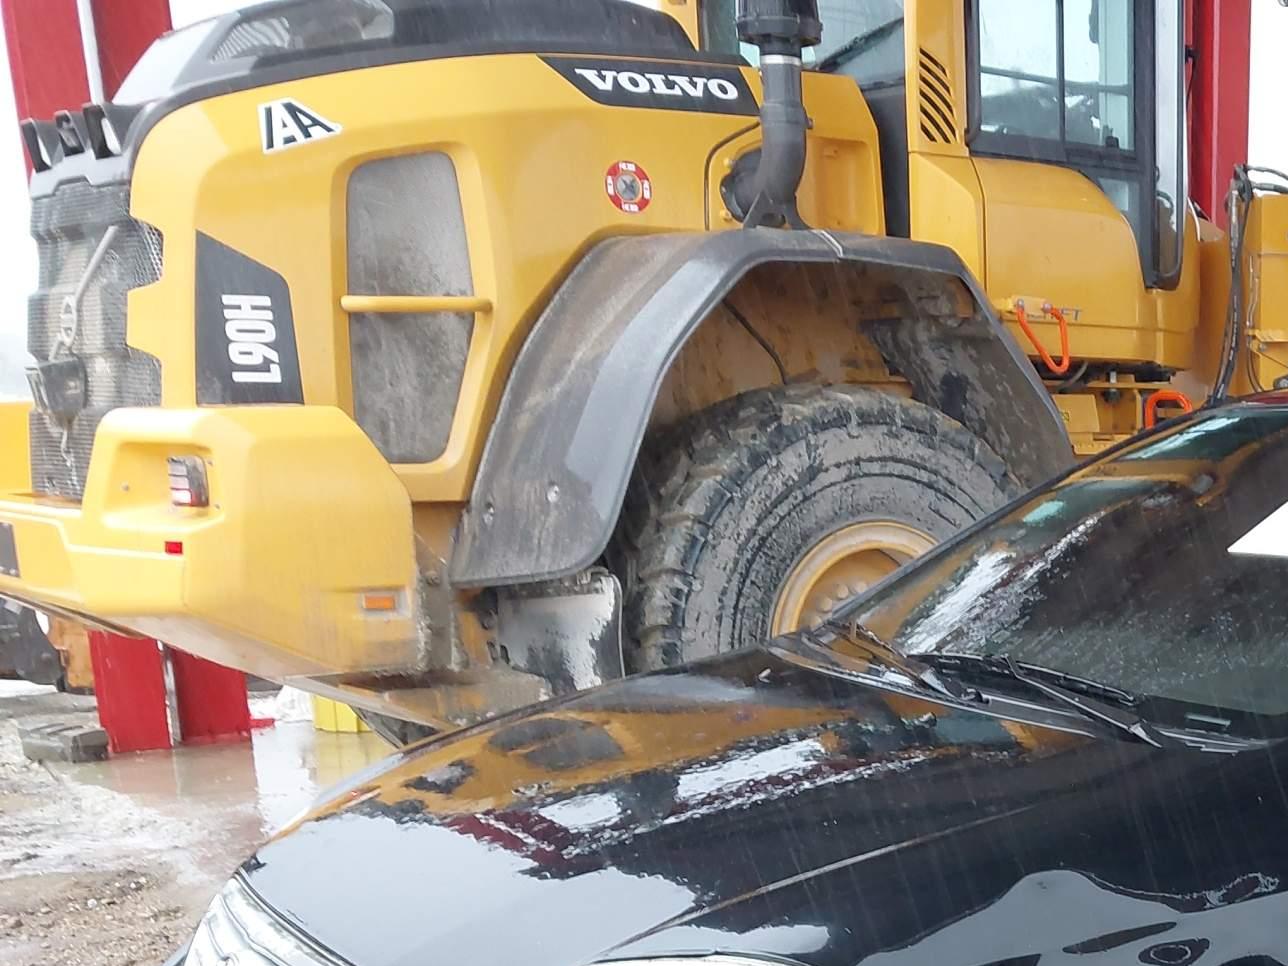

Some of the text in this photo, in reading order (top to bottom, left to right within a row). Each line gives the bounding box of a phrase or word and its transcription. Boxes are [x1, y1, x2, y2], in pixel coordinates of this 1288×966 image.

[574, 67, 739, 100] VOLVO
[261, 100, 337, 151] IAA
[221, 294, 282, 383] L90H
